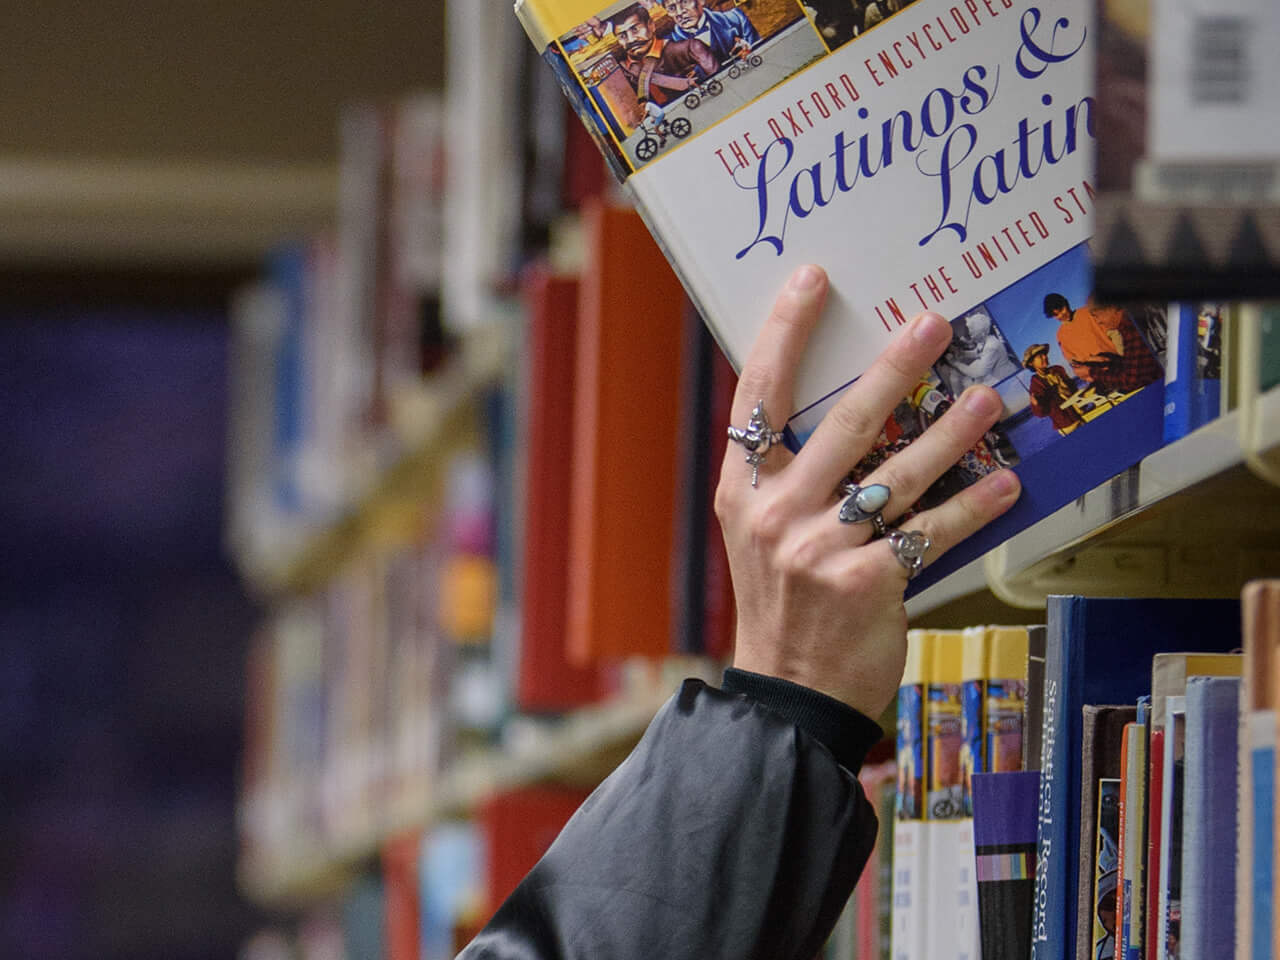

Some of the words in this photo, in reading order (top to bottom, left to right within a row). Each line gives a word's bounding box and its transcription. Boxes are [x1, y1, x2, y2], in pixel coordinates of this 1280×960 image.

[715, 131, 763, 176] THE
[767, 73, 861, 147] OXFORD
[732, 64, 1000, 260] Latinos
[1015, 7, 1087, 79] &
[874, 297, 906, 332] IN
[909, 266, 959, 310] THE
[961, 211, 1050, 280] UNITED
[1044, 679, 1057, 824] Statistical
[1038, 839, 1052, 942] Record
